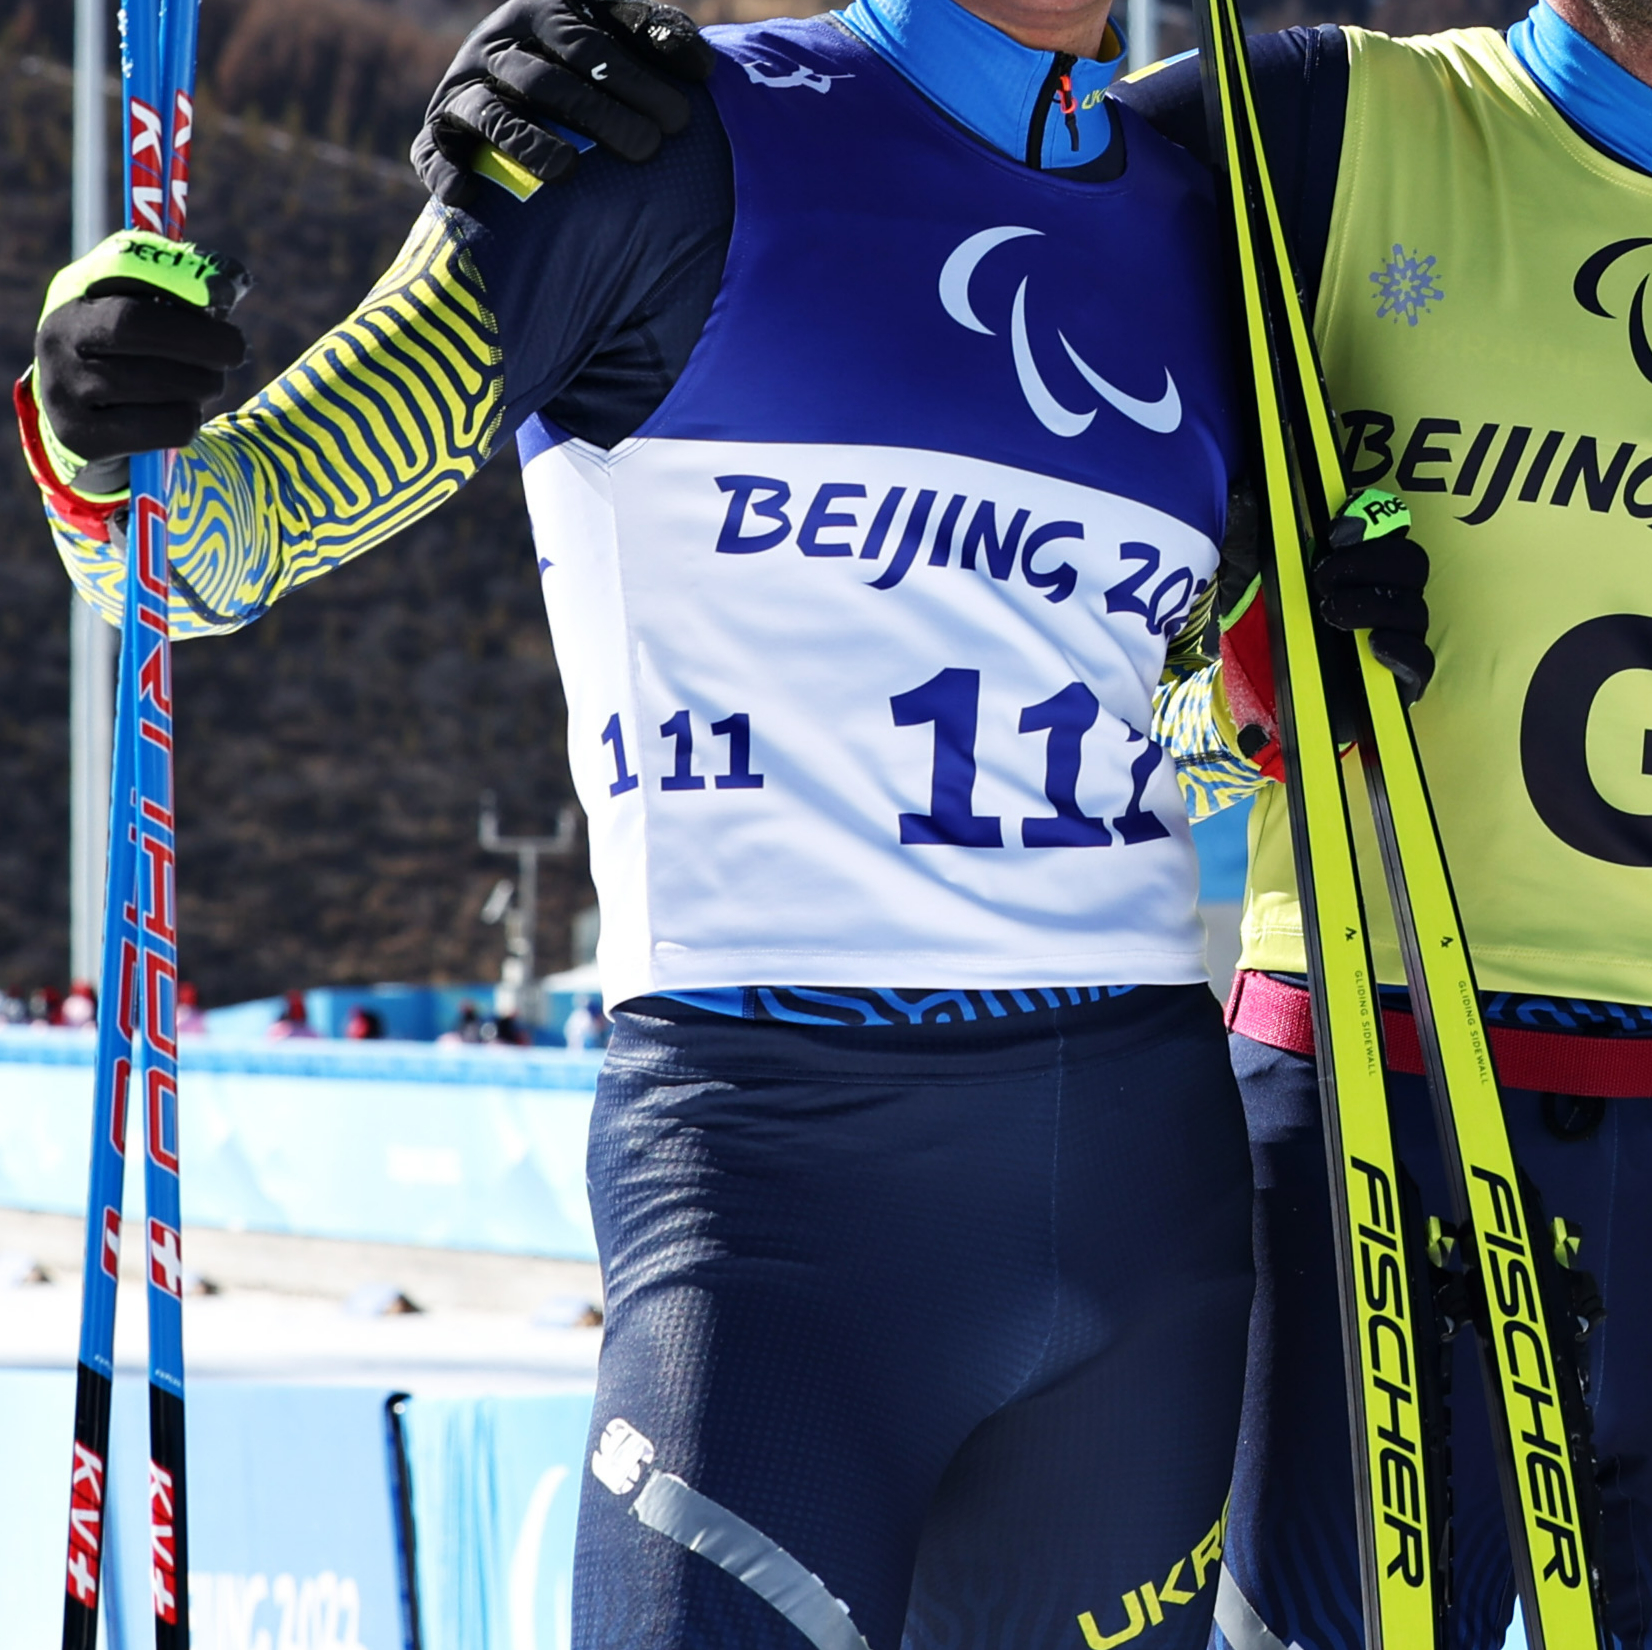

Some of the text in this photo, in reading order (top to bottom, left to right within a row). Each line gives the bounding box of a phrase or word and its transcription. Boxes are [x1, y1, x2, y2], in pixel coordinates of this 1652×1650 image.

[712, 473, 1085, 606] BEIJING
[1355, 970, 1377, 1077] GLIDING SIDEWALL
[1458, 980, 1489, 1085] GLIDING SIDEWALL
[1351, 1154, 1425, 1590] FISCHER
[1469, 1164, 1581, 1590] FISCHER
